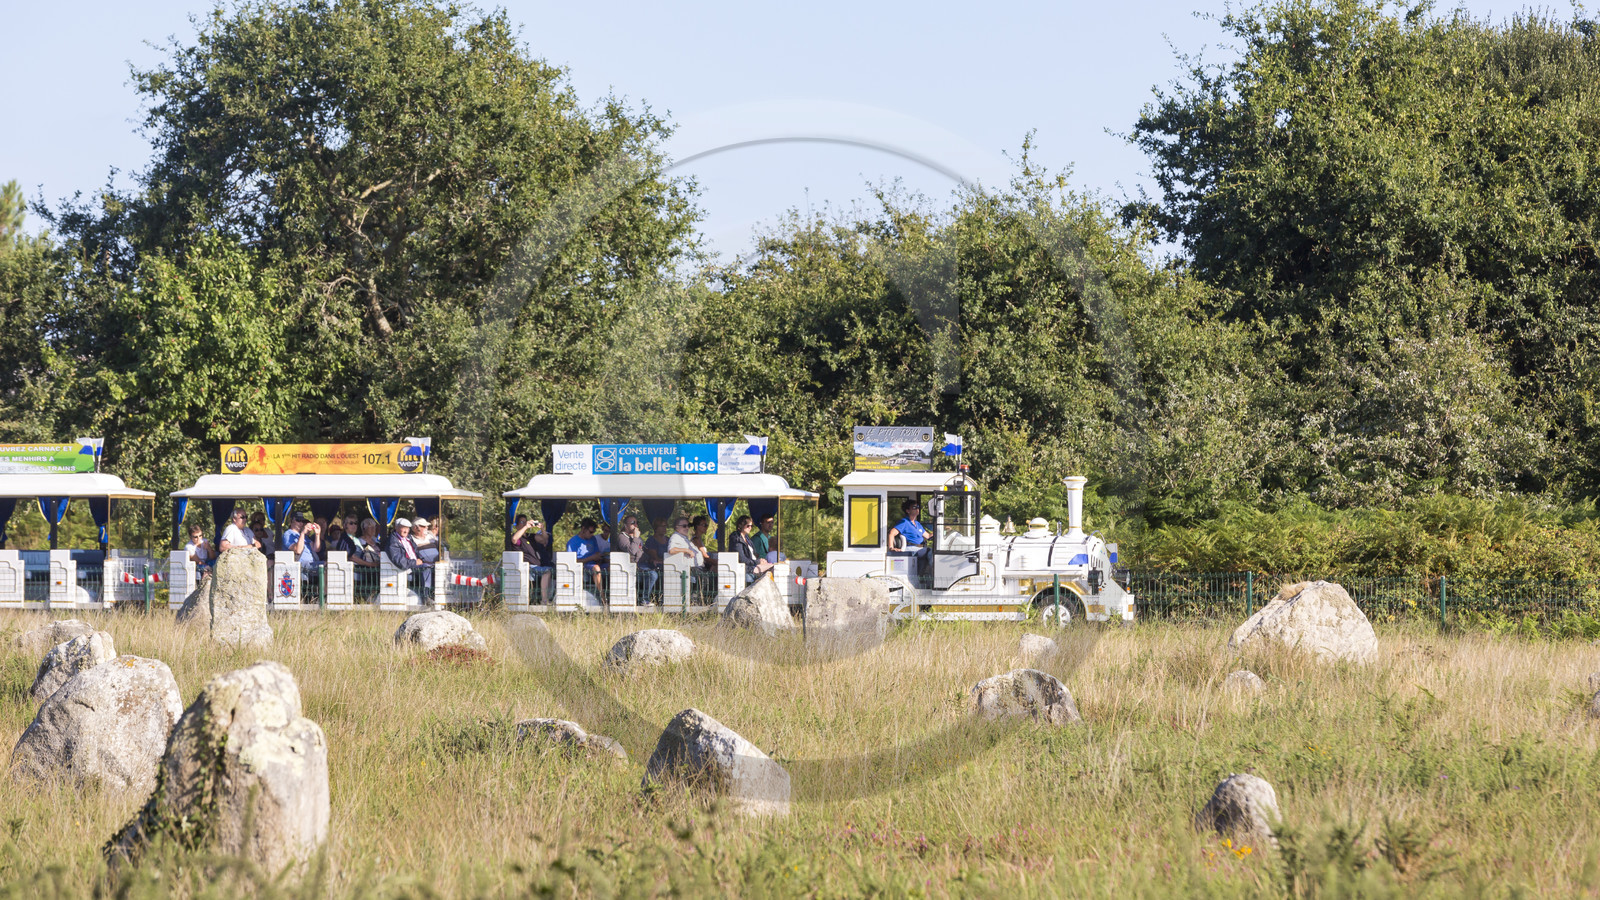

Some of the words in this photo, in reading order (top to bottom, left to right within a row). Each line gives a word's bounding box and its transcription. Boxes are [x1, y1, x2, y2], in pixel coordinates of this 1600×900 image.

[227, 450, 246, 462] hit
[558, 449, 584, 459] Vente
[618, 447, 677, 455] CONSERVERIE
[362, 453, 390, 465] 107.1
[618, 457, 632, 472] la
[635, 456, 715, 472] belle-iloise
[555, 460, 587, 470] directe
